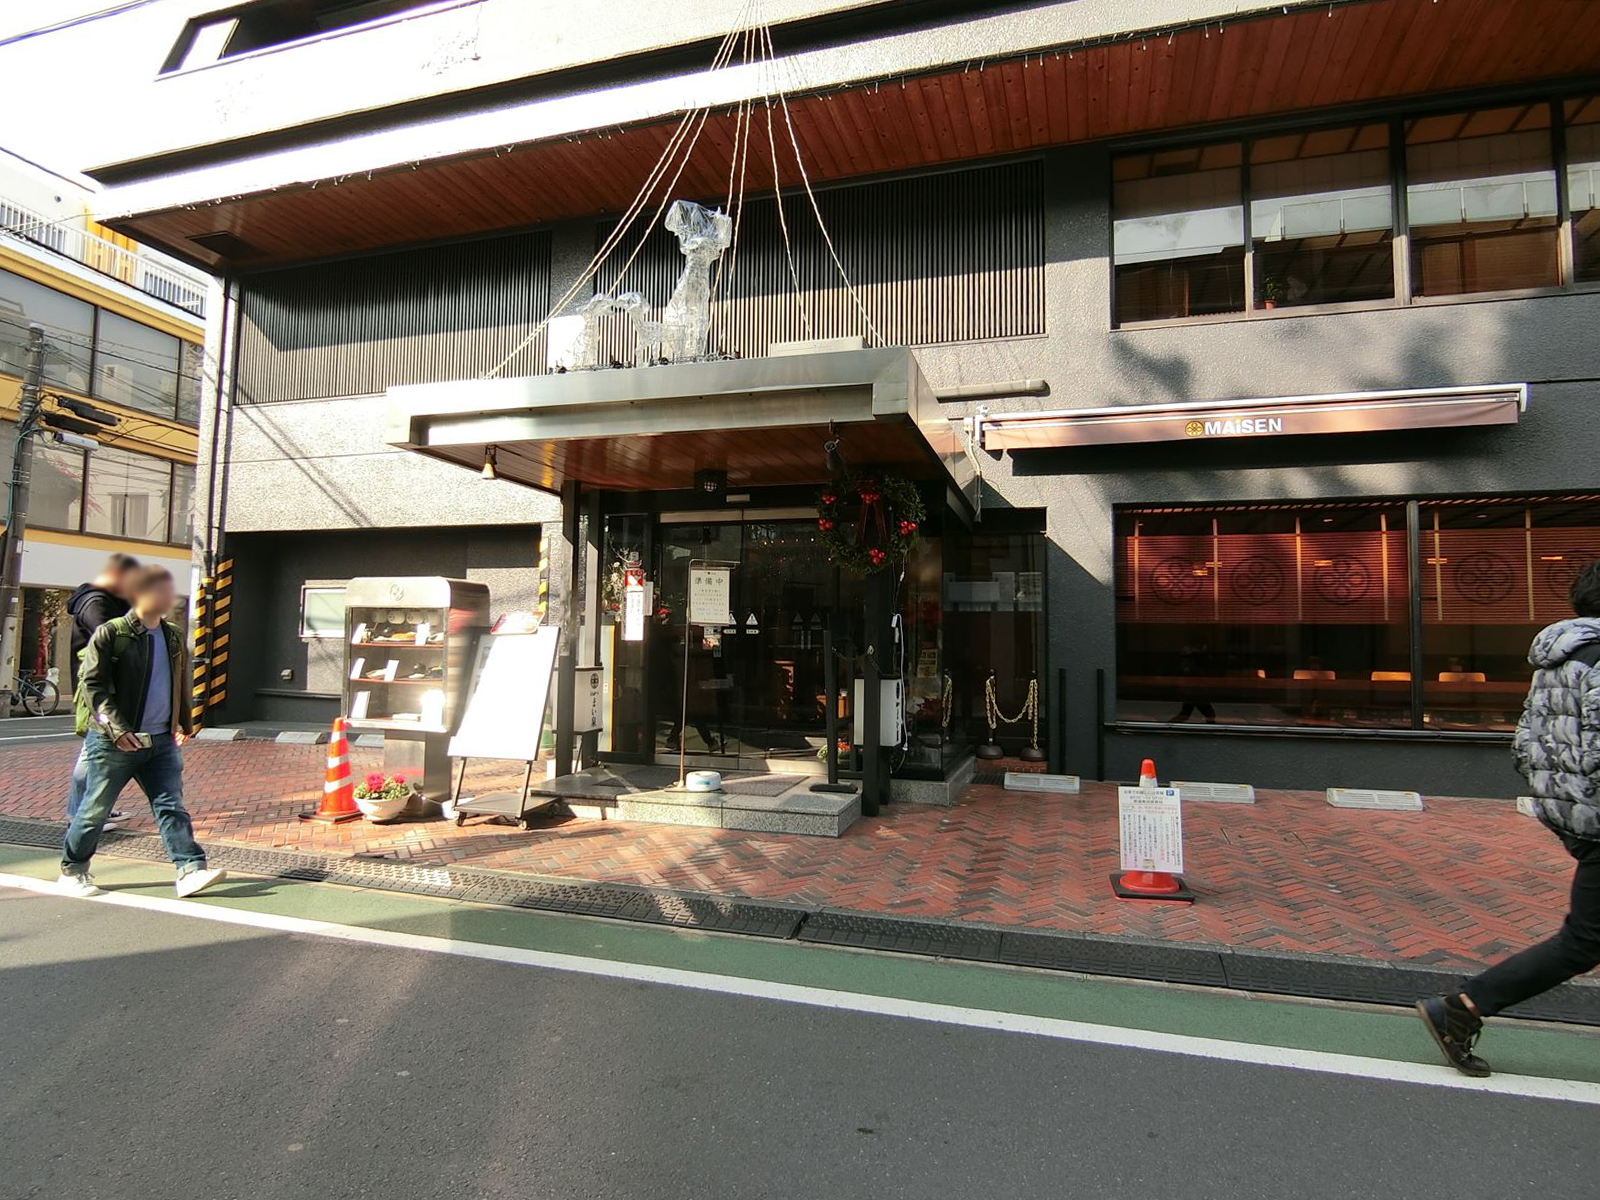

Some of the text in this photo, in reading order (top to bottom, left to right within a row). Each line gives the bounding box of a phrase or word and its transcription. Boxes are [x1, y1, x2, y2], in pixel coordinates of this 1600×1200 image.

[1204, 418, 1282, 435] MAiSEN
[694, 577, 723, 586] 準備中
